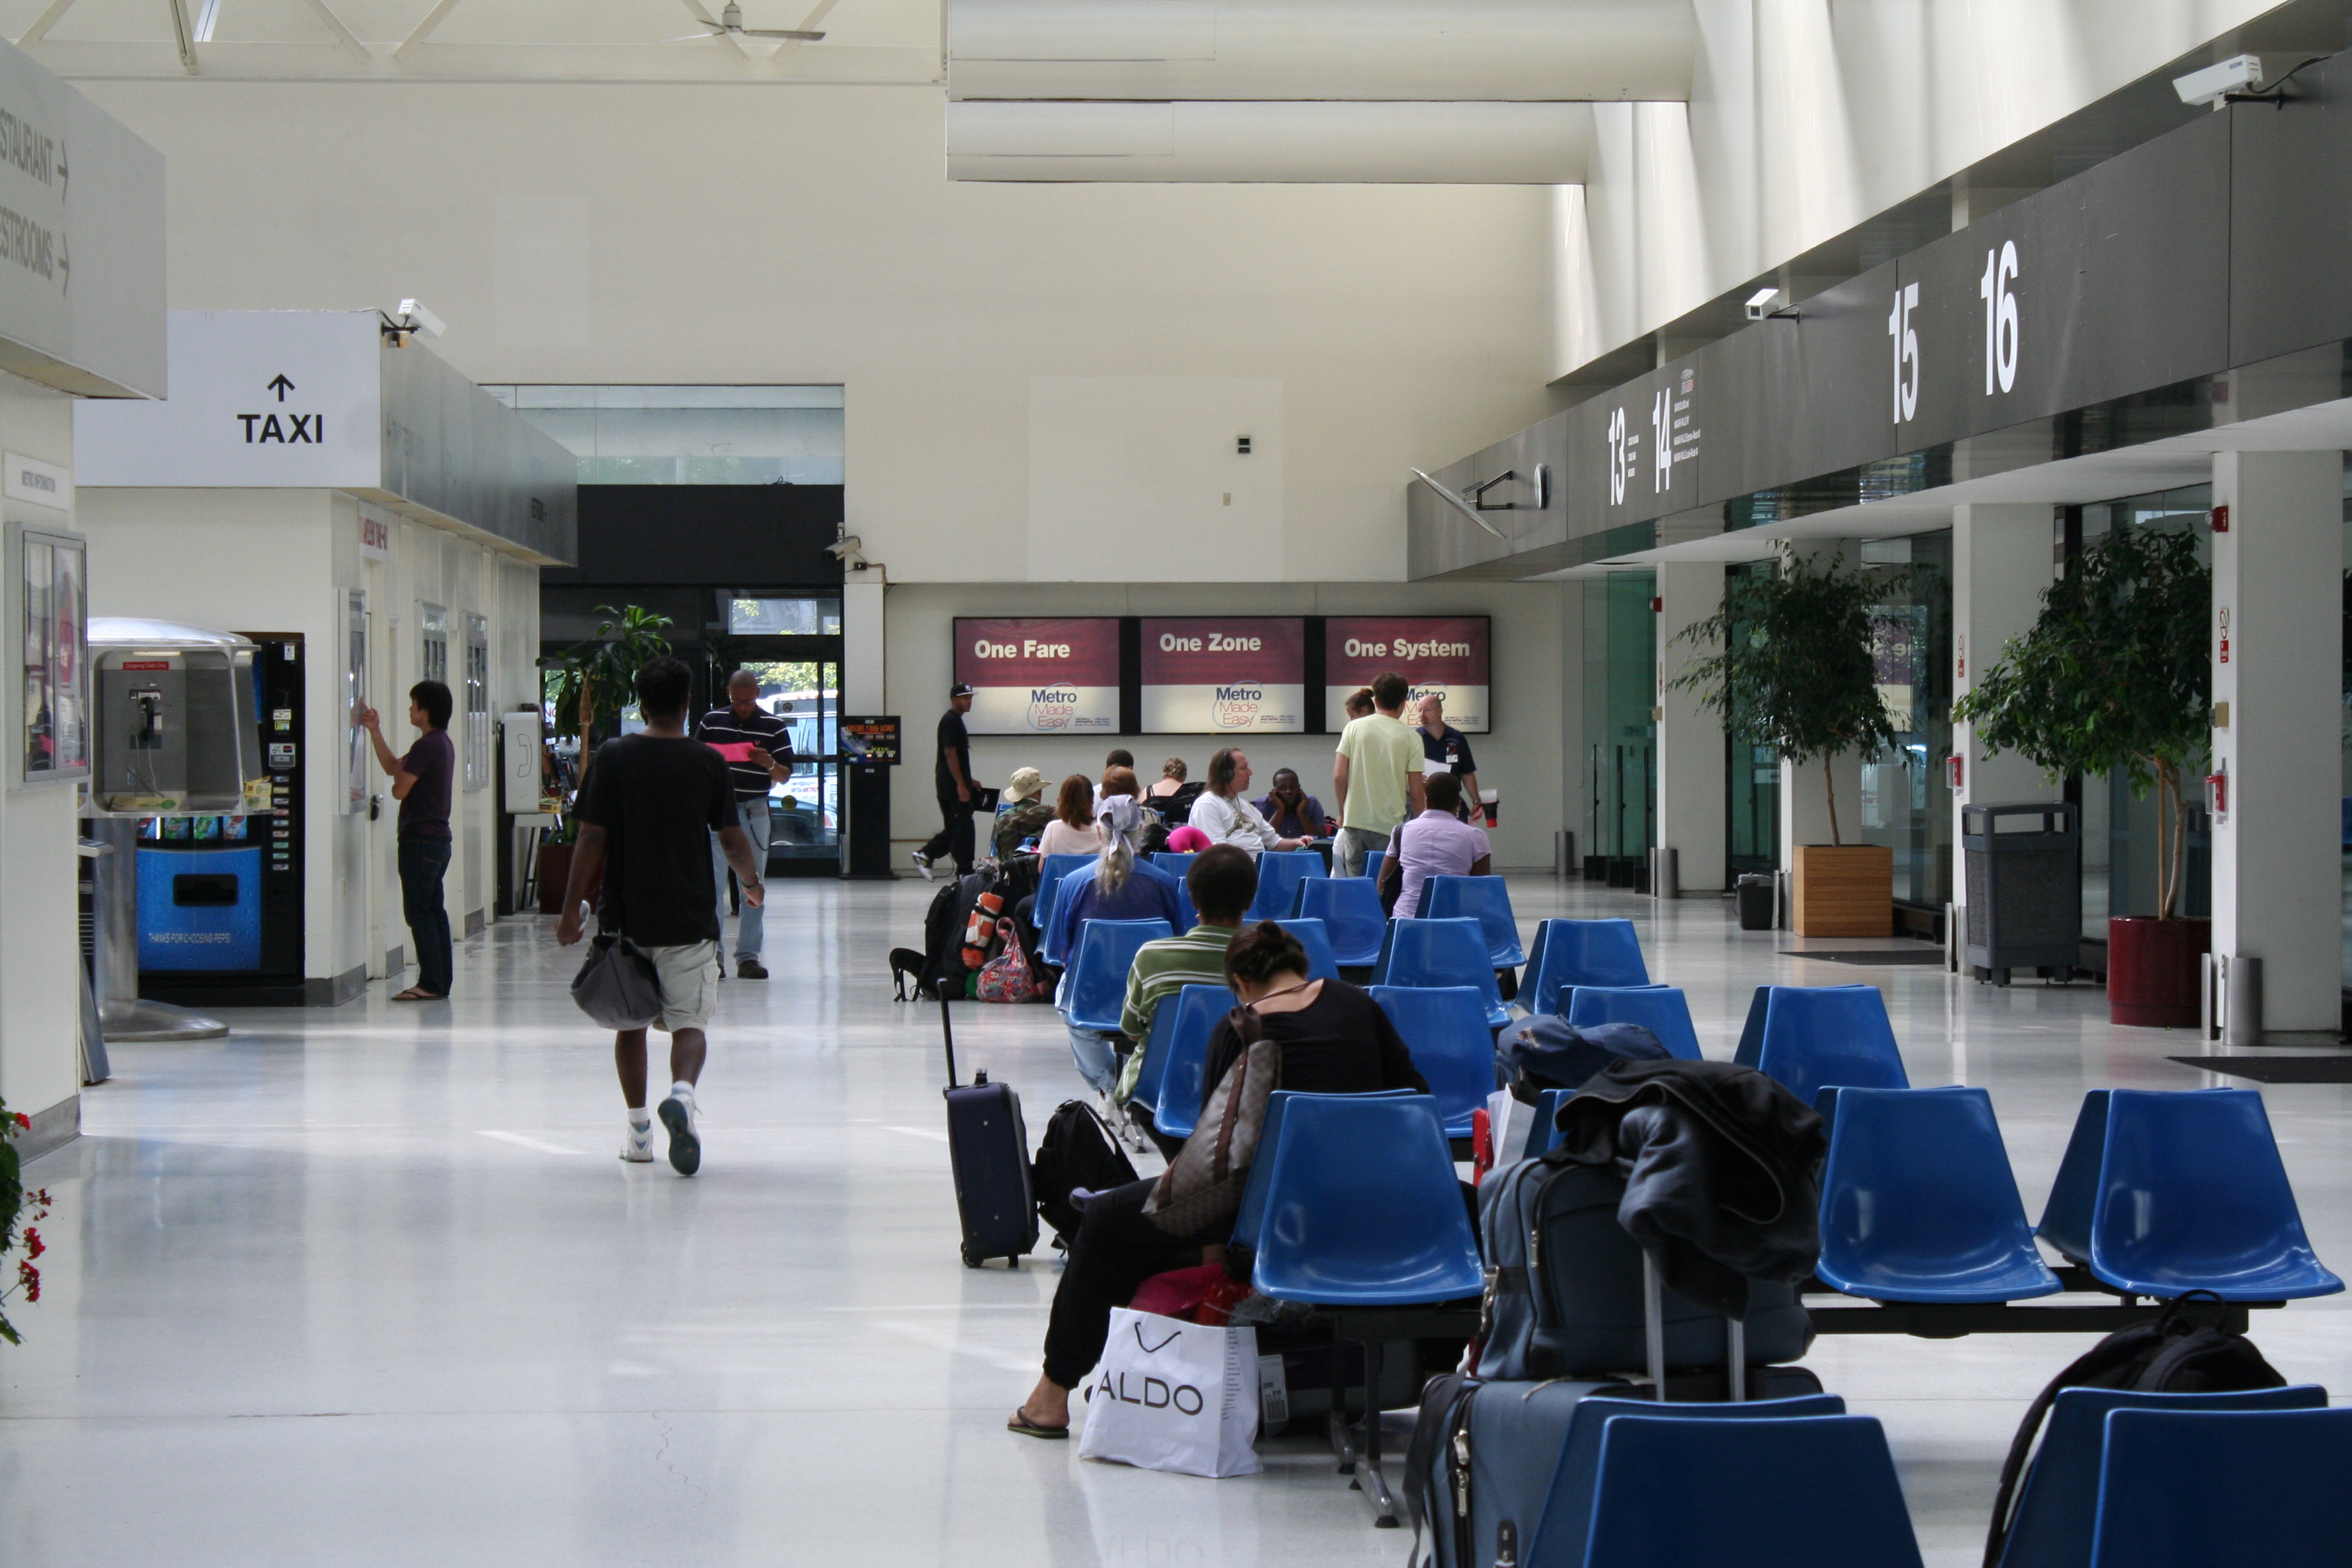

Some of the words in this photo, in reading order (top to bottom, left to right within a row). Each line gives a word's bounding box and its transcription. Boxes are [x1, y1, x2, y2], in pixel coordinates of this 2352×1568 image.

[0, 206, 52, 281] STROOMS
[1981, 240, 2019, 396] 16
[1889, 282, 1919, 425] 15
[237, 414, 323, 443] TAXI
[1652, 387, 1672, 493] 14
[1608, 407, 1626, 506] 13
[975, 640, 1017, 658] One
[1024, 640, 1071, 658] Fare
[1160, 633, 1202, 651] One
[1208, 633, 1261, 651] Zone
[1345, 638, 1387, 657] One
[1393, 638, 1470, 661] System
[1032, 690, 1077, 702] Metro
[1216, 687, 1262, 700] Metro
[1034, 704, 1073, 715] Made
[1220, 702, 1258, 713] Made
[1038, 716, 1070, 729] Easy
[1223, 713, 1254, 727] Easy
[148, 933, 170, 943] THANKS
[171, 933, 184, 943] FOR
[184, 933, 214, 943] CHOOSING
[1096, 1369, 1203, 1416] ALDO
